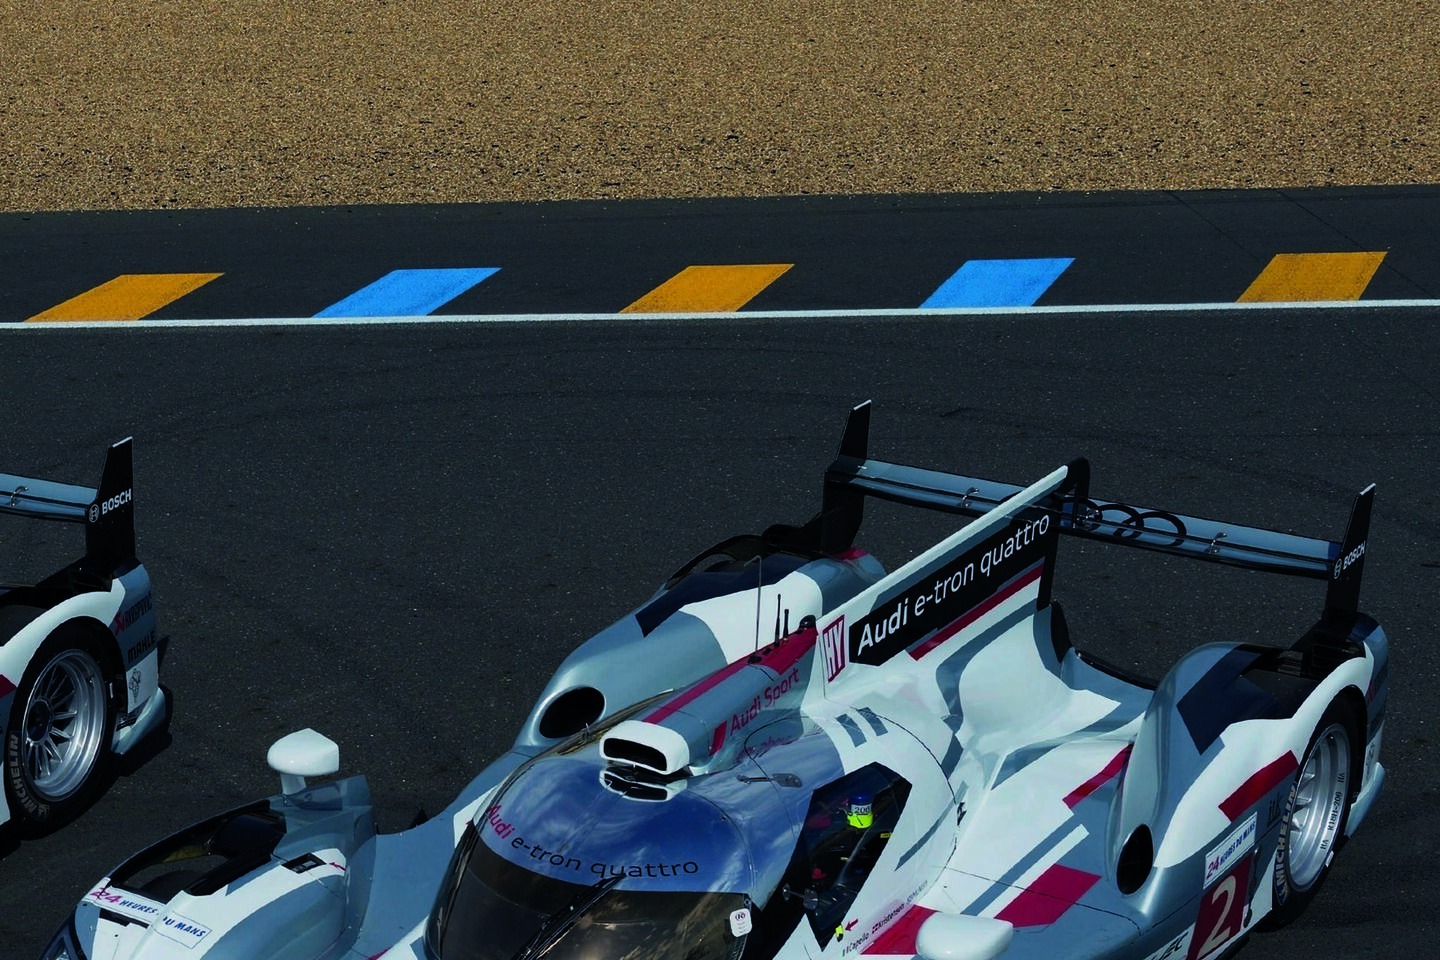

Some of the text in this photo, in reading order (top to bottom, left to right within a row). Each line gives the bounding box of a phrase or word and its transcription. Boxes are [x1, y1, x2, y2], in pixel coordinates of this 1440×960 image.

[102, 488, 132, 515] BOSCH
[857, 514, 1050, 657] Audi e-tron quattro
[1343, 540, 1366, 570] BOSCH
[128, 630, 156, 664] MAHLE
[824, 619, 845, 681] HY
[730, 667, 799, 736] Audi Sport
[9, 734, 38, 814] MICHELIN
[487, 803, 699, 879] Audi e-tron quattro
[1206, 855, 1220, 879] 24
[1276, 784, 1296, 887] MICHELIN
[119, 900, 158, 914] HEURES
[174, 922, 206, 937] MANS
[1196, 875, 1237, 960] 2
